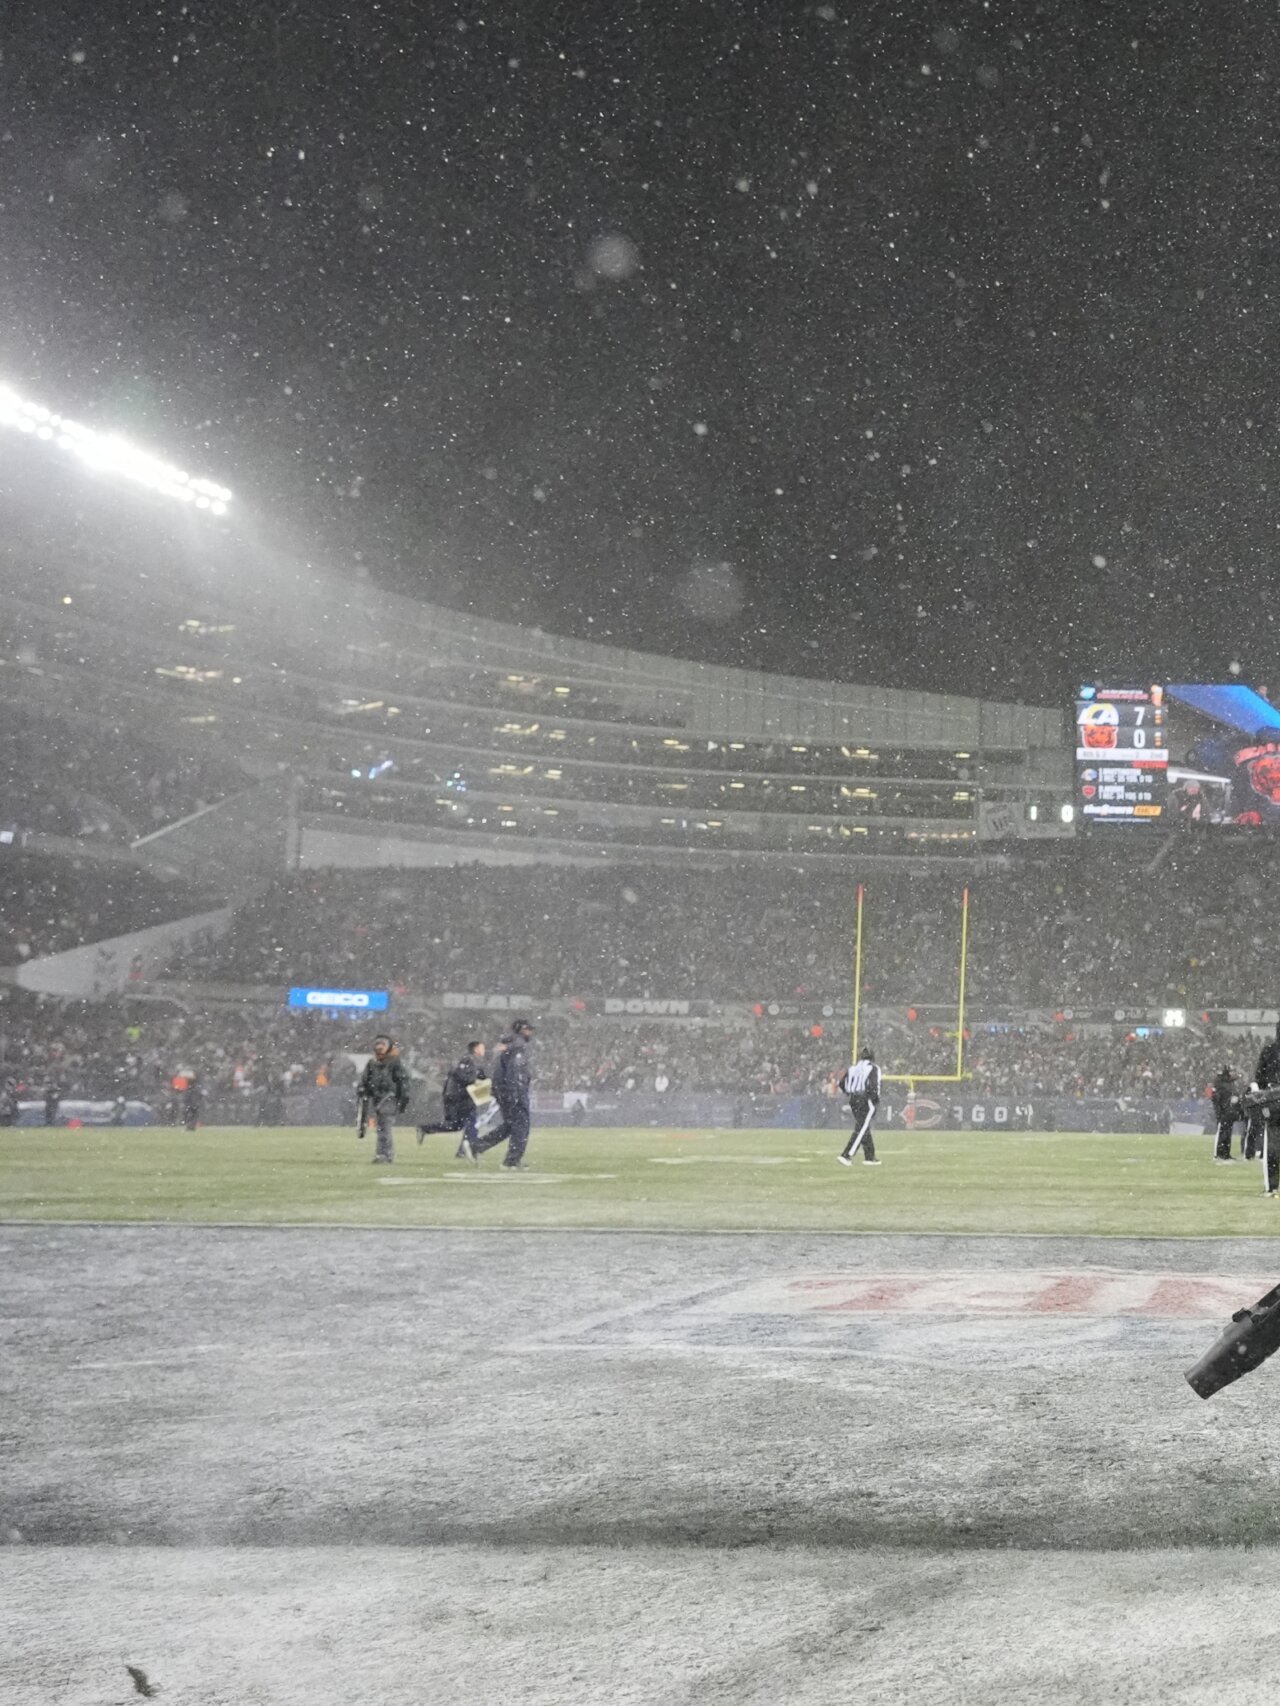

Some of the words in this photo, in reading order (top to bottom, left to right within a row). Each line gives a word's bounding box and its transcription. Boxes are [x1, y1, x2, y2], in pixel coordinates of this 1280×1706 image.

[1134, 707, 1146, 726] 7
[1133, 729, 1146, 748] 0
[306, 991, 370, 1006] GEICO
[605, 999, 690, 1014] DOWN
